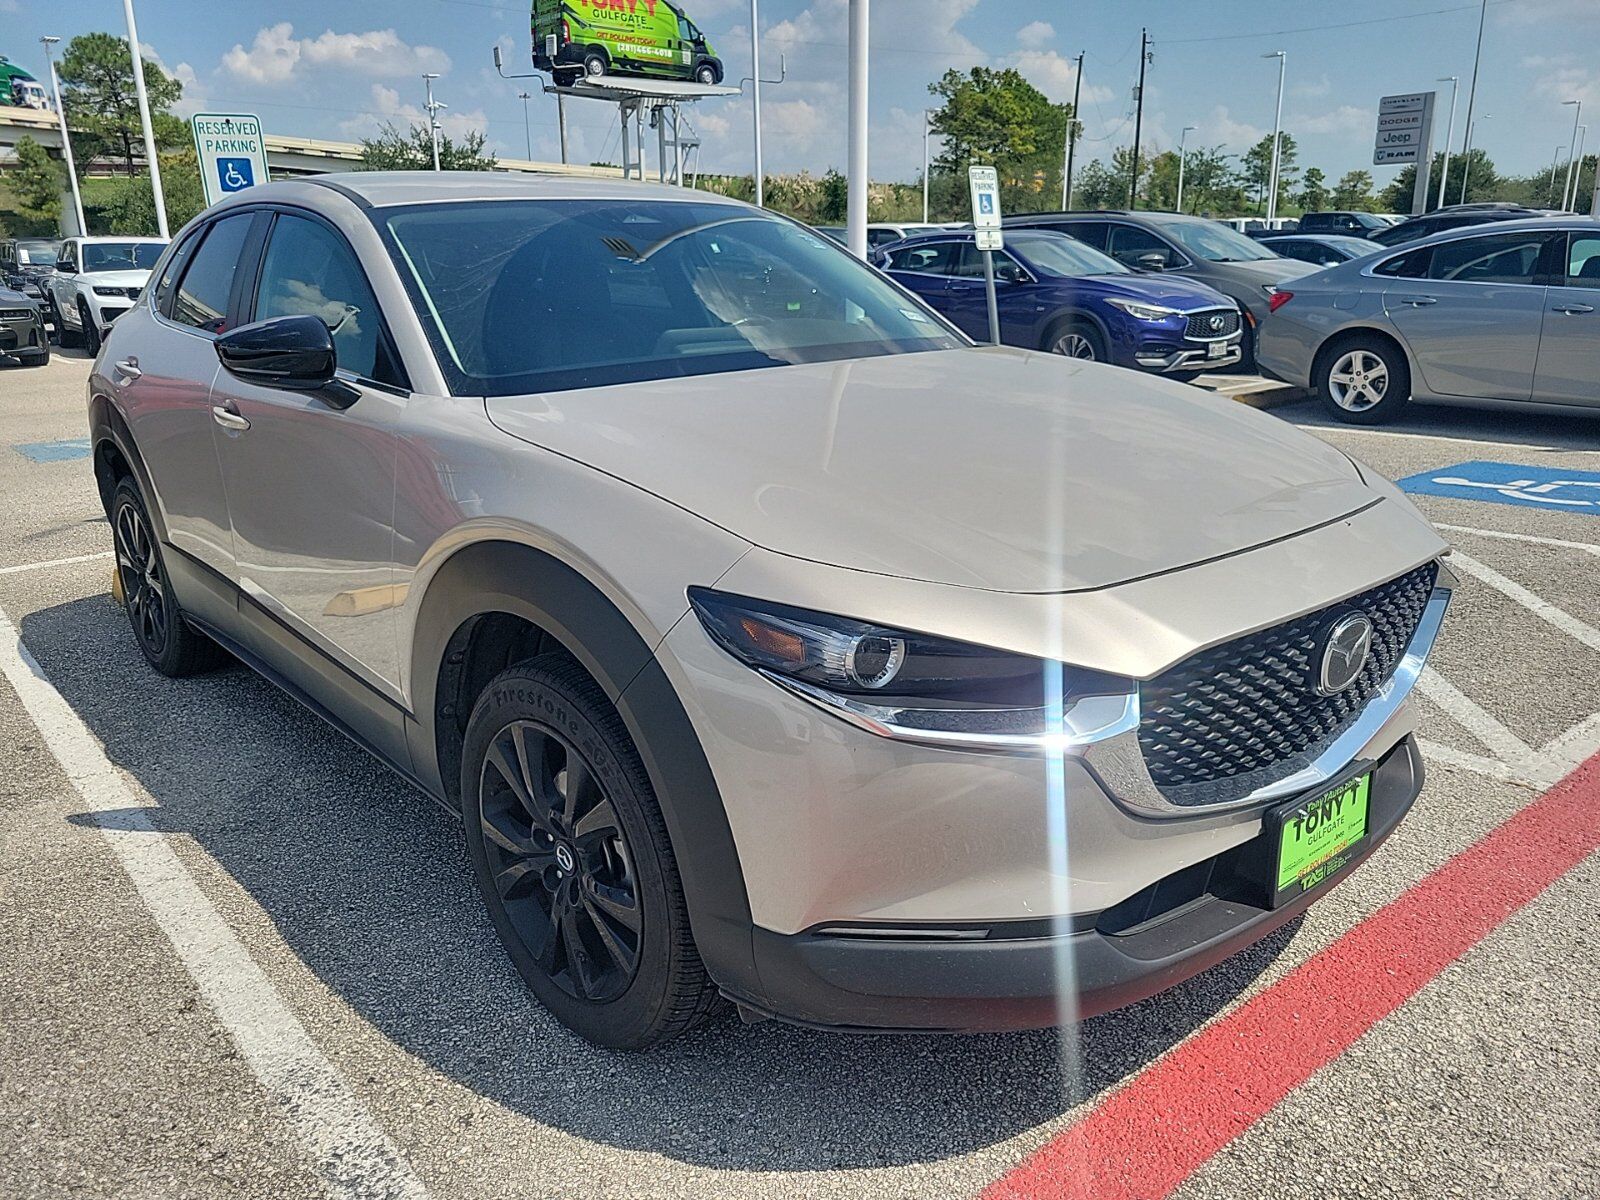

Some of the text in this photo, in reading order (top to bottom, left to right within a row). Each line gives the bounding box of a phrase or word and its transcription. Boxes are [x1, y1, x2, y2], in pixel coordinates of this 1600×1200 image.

[592, 9, 647, 24] GULFGATE
[597, 31, 609, 39] GET
[610, 33, 635, 43] ROLLING
[197, 121, 258, 136] RESERVED
[1380, 117, 1419, 126] DODGE
[1383, 133, 1411, 143] Jeep
[206, 139, 257, 153] PARKING
[974, 182, 995, 192] PARKING
[493, 688, 580, 736] Firestone
[1292, 782, 1362, 843] TONY T
[1307, 814, 1345, 846] GULFGATE
